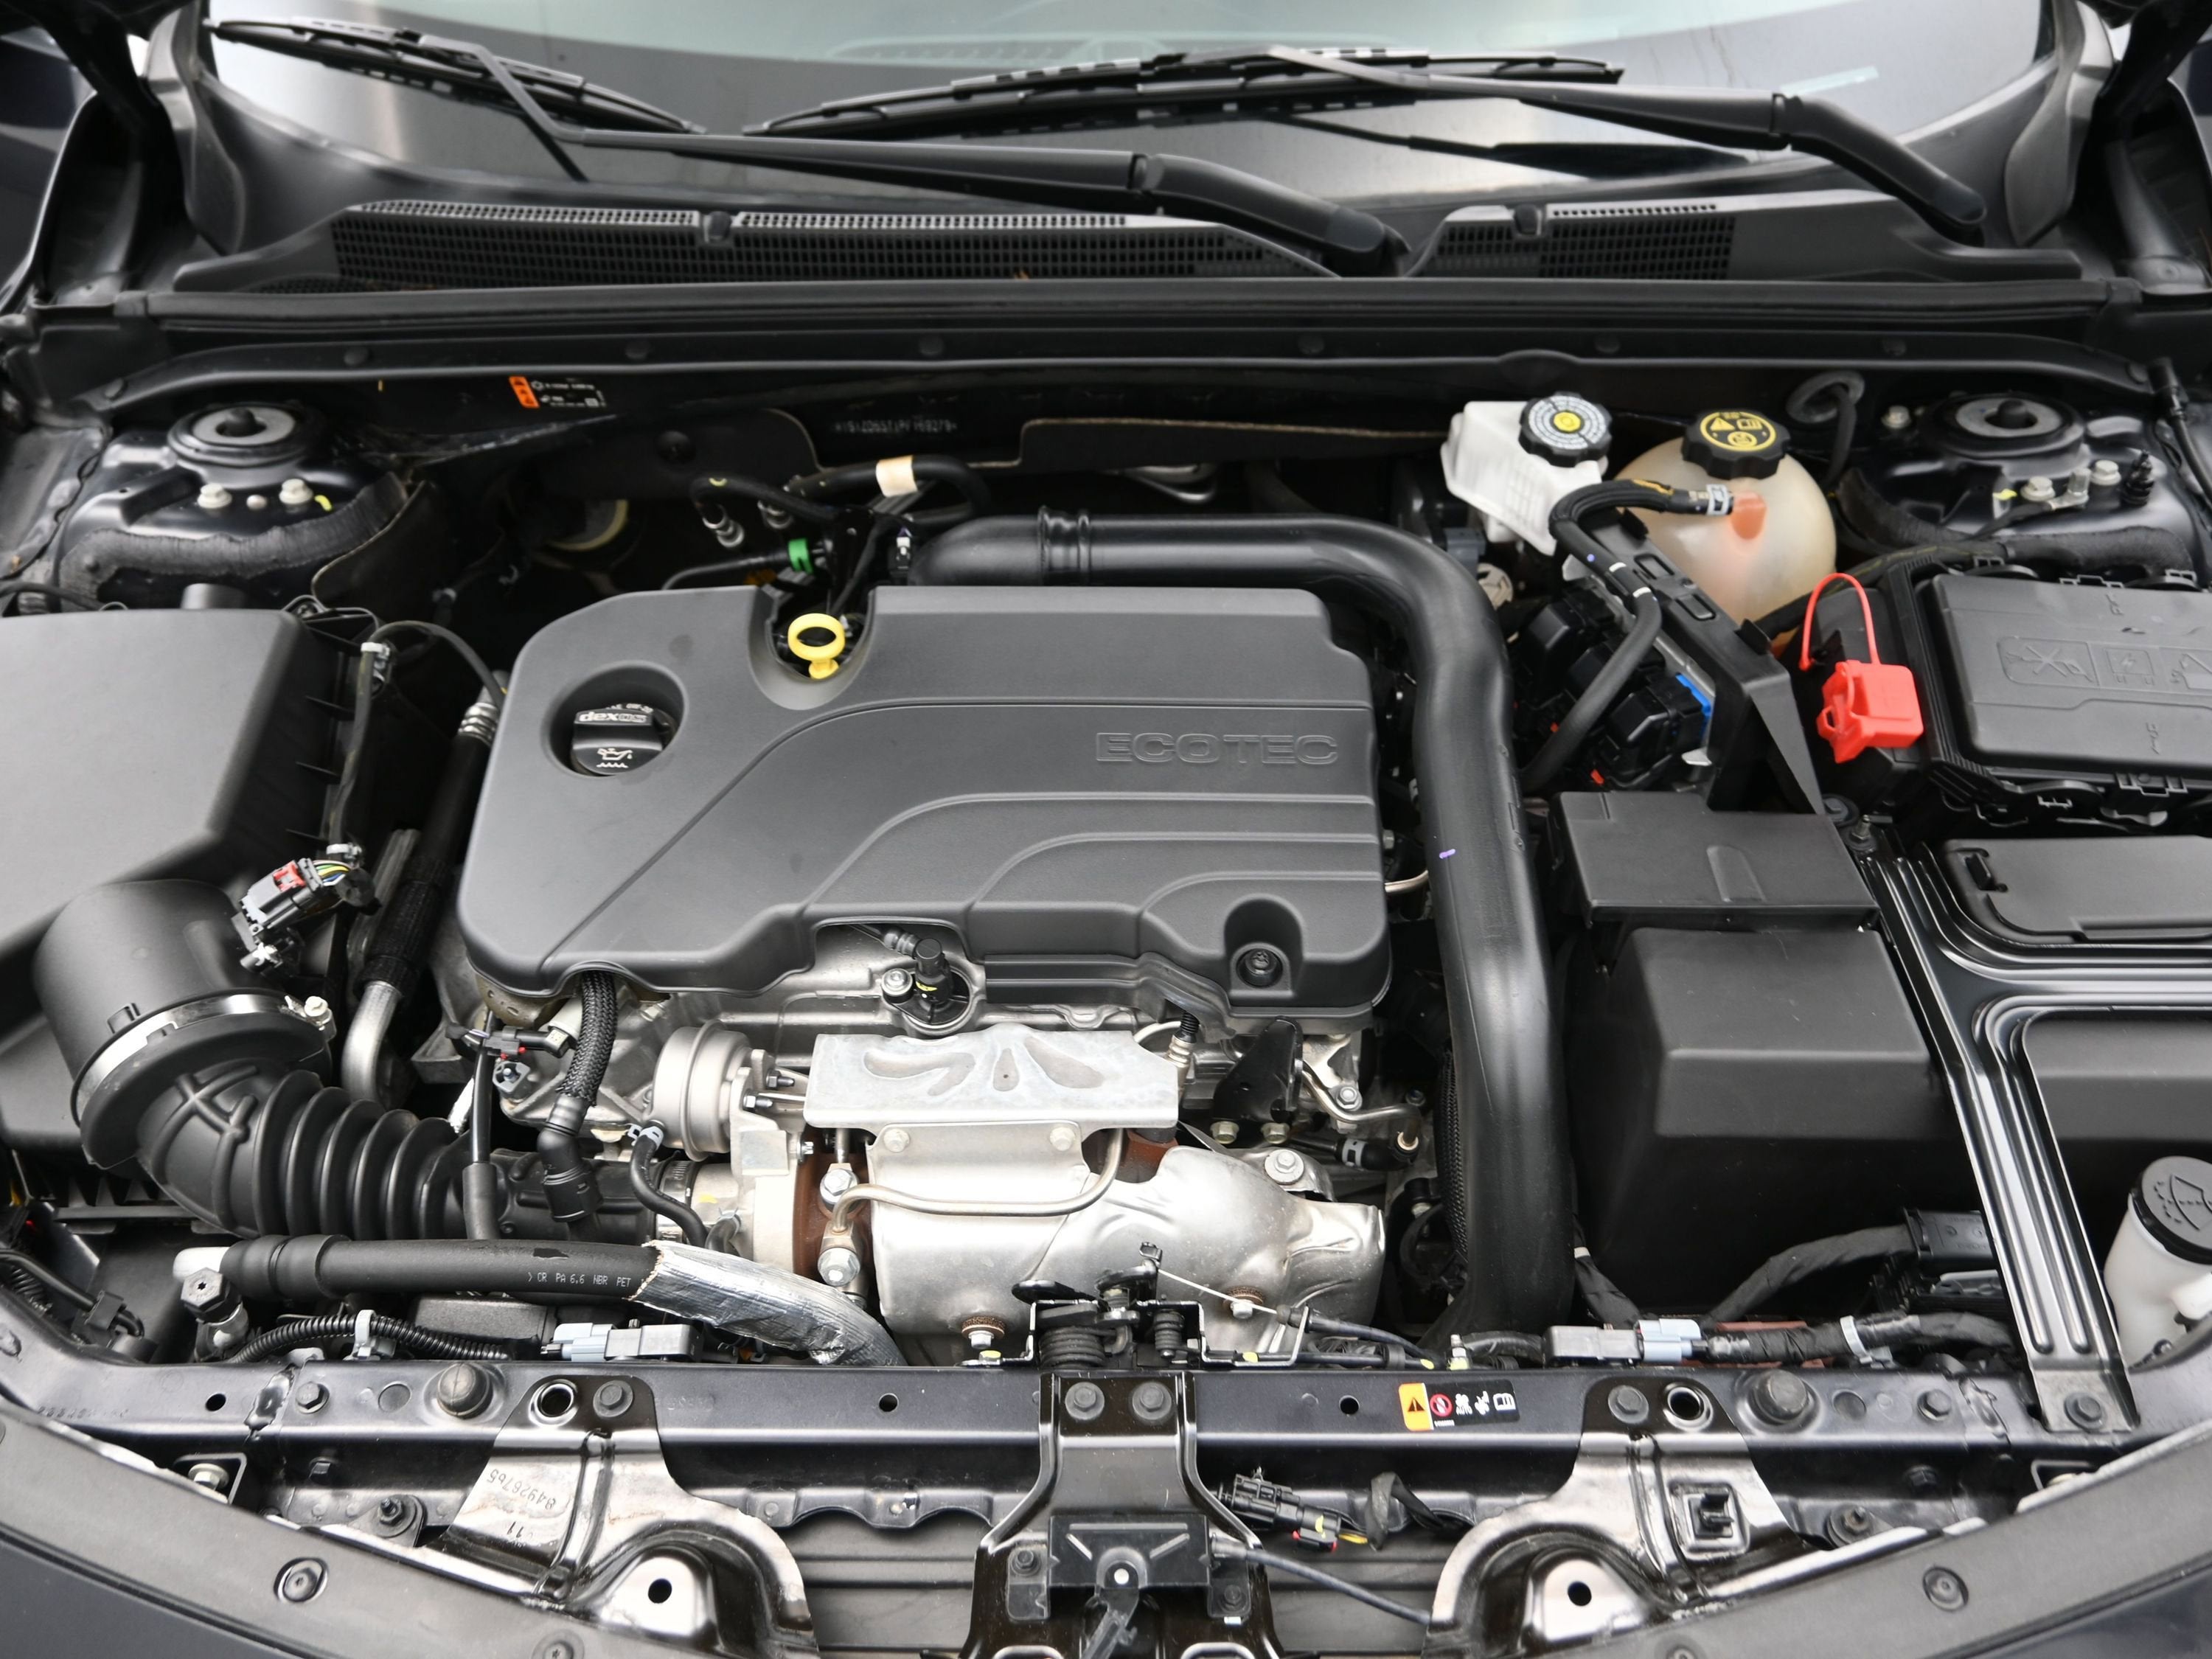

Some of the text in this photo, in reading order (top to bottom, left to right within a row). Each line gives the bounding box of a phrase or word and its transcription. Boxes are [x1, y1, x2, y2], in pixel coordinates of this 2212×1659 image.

[579, 711, 647, 723] dexos
[1096, 732, 1339, 766] ECOTEC
[555, 1273, 566, 1283] PA
[593, 1274, 608, 1286] NBR
[616, 1276, 632, 1287] PET
